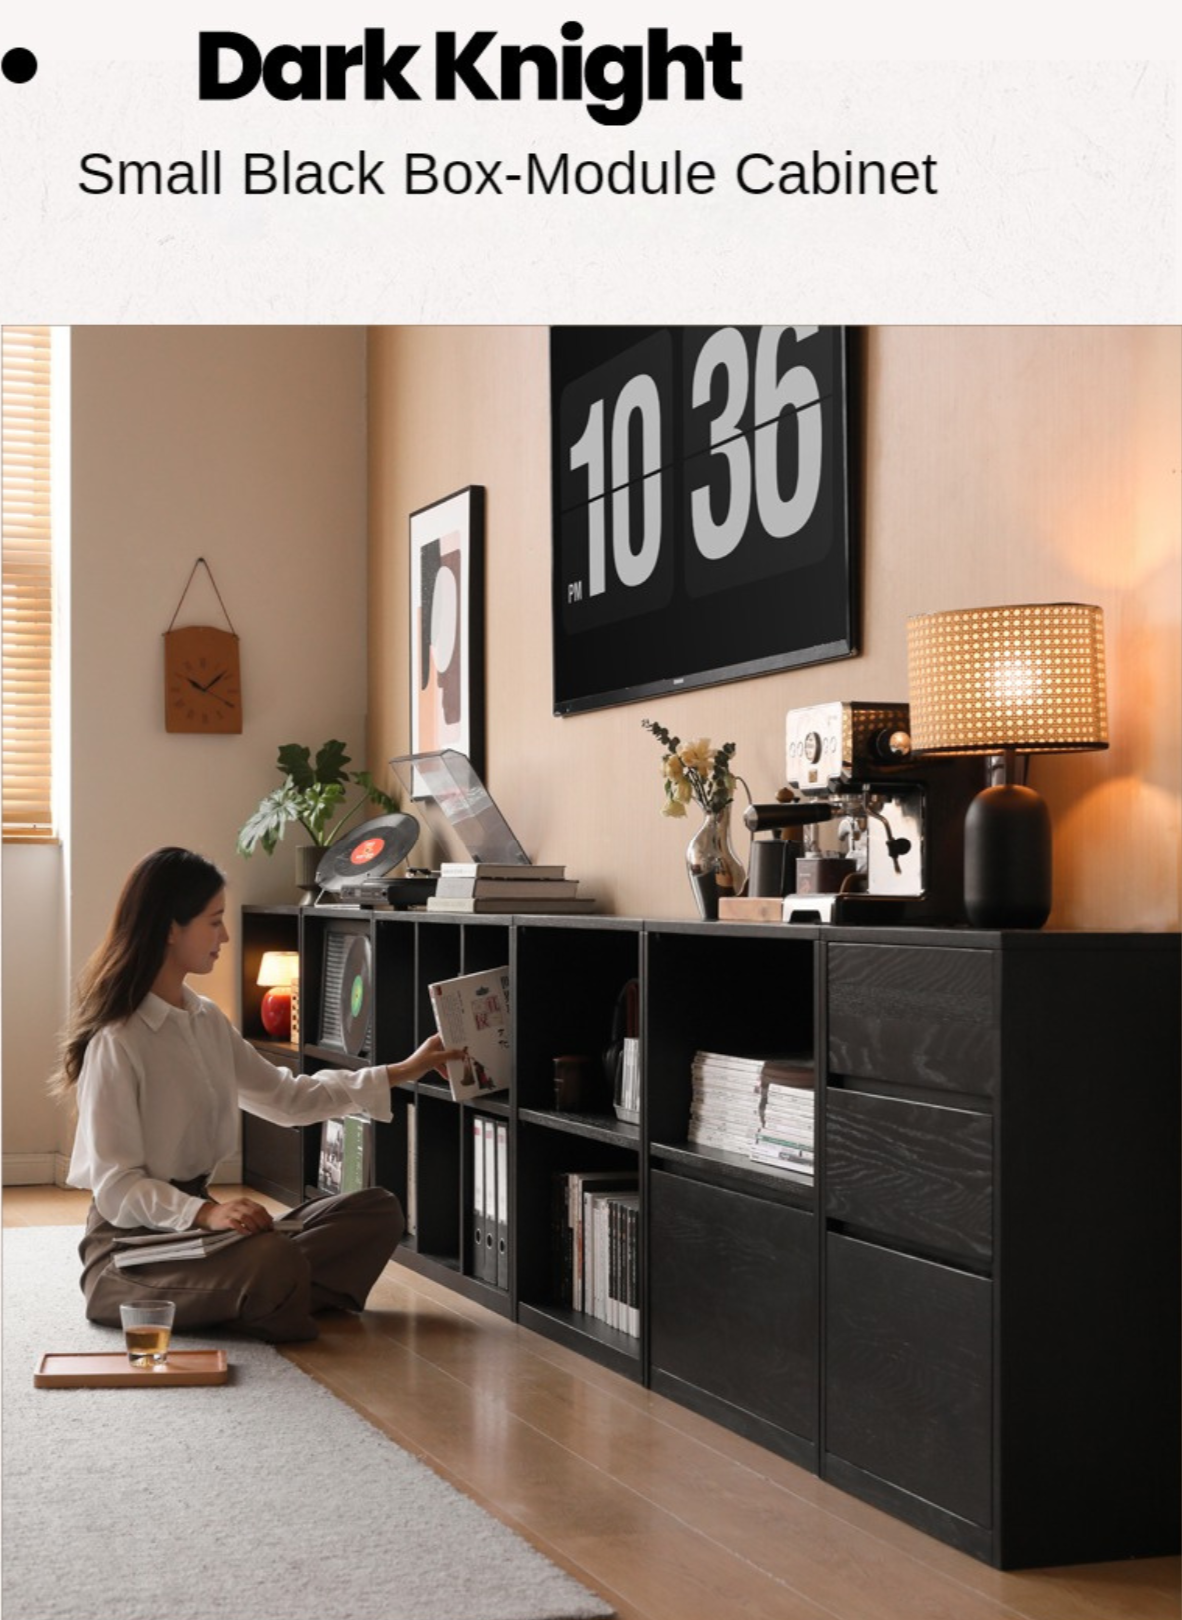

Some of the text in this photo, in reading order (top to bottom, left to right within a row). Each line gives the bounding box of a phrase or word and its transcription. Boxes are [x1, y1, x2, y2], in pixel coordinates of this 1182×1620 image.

[569, 326, 823, 597] 10 36
[567, 580, 583, 604] PM
